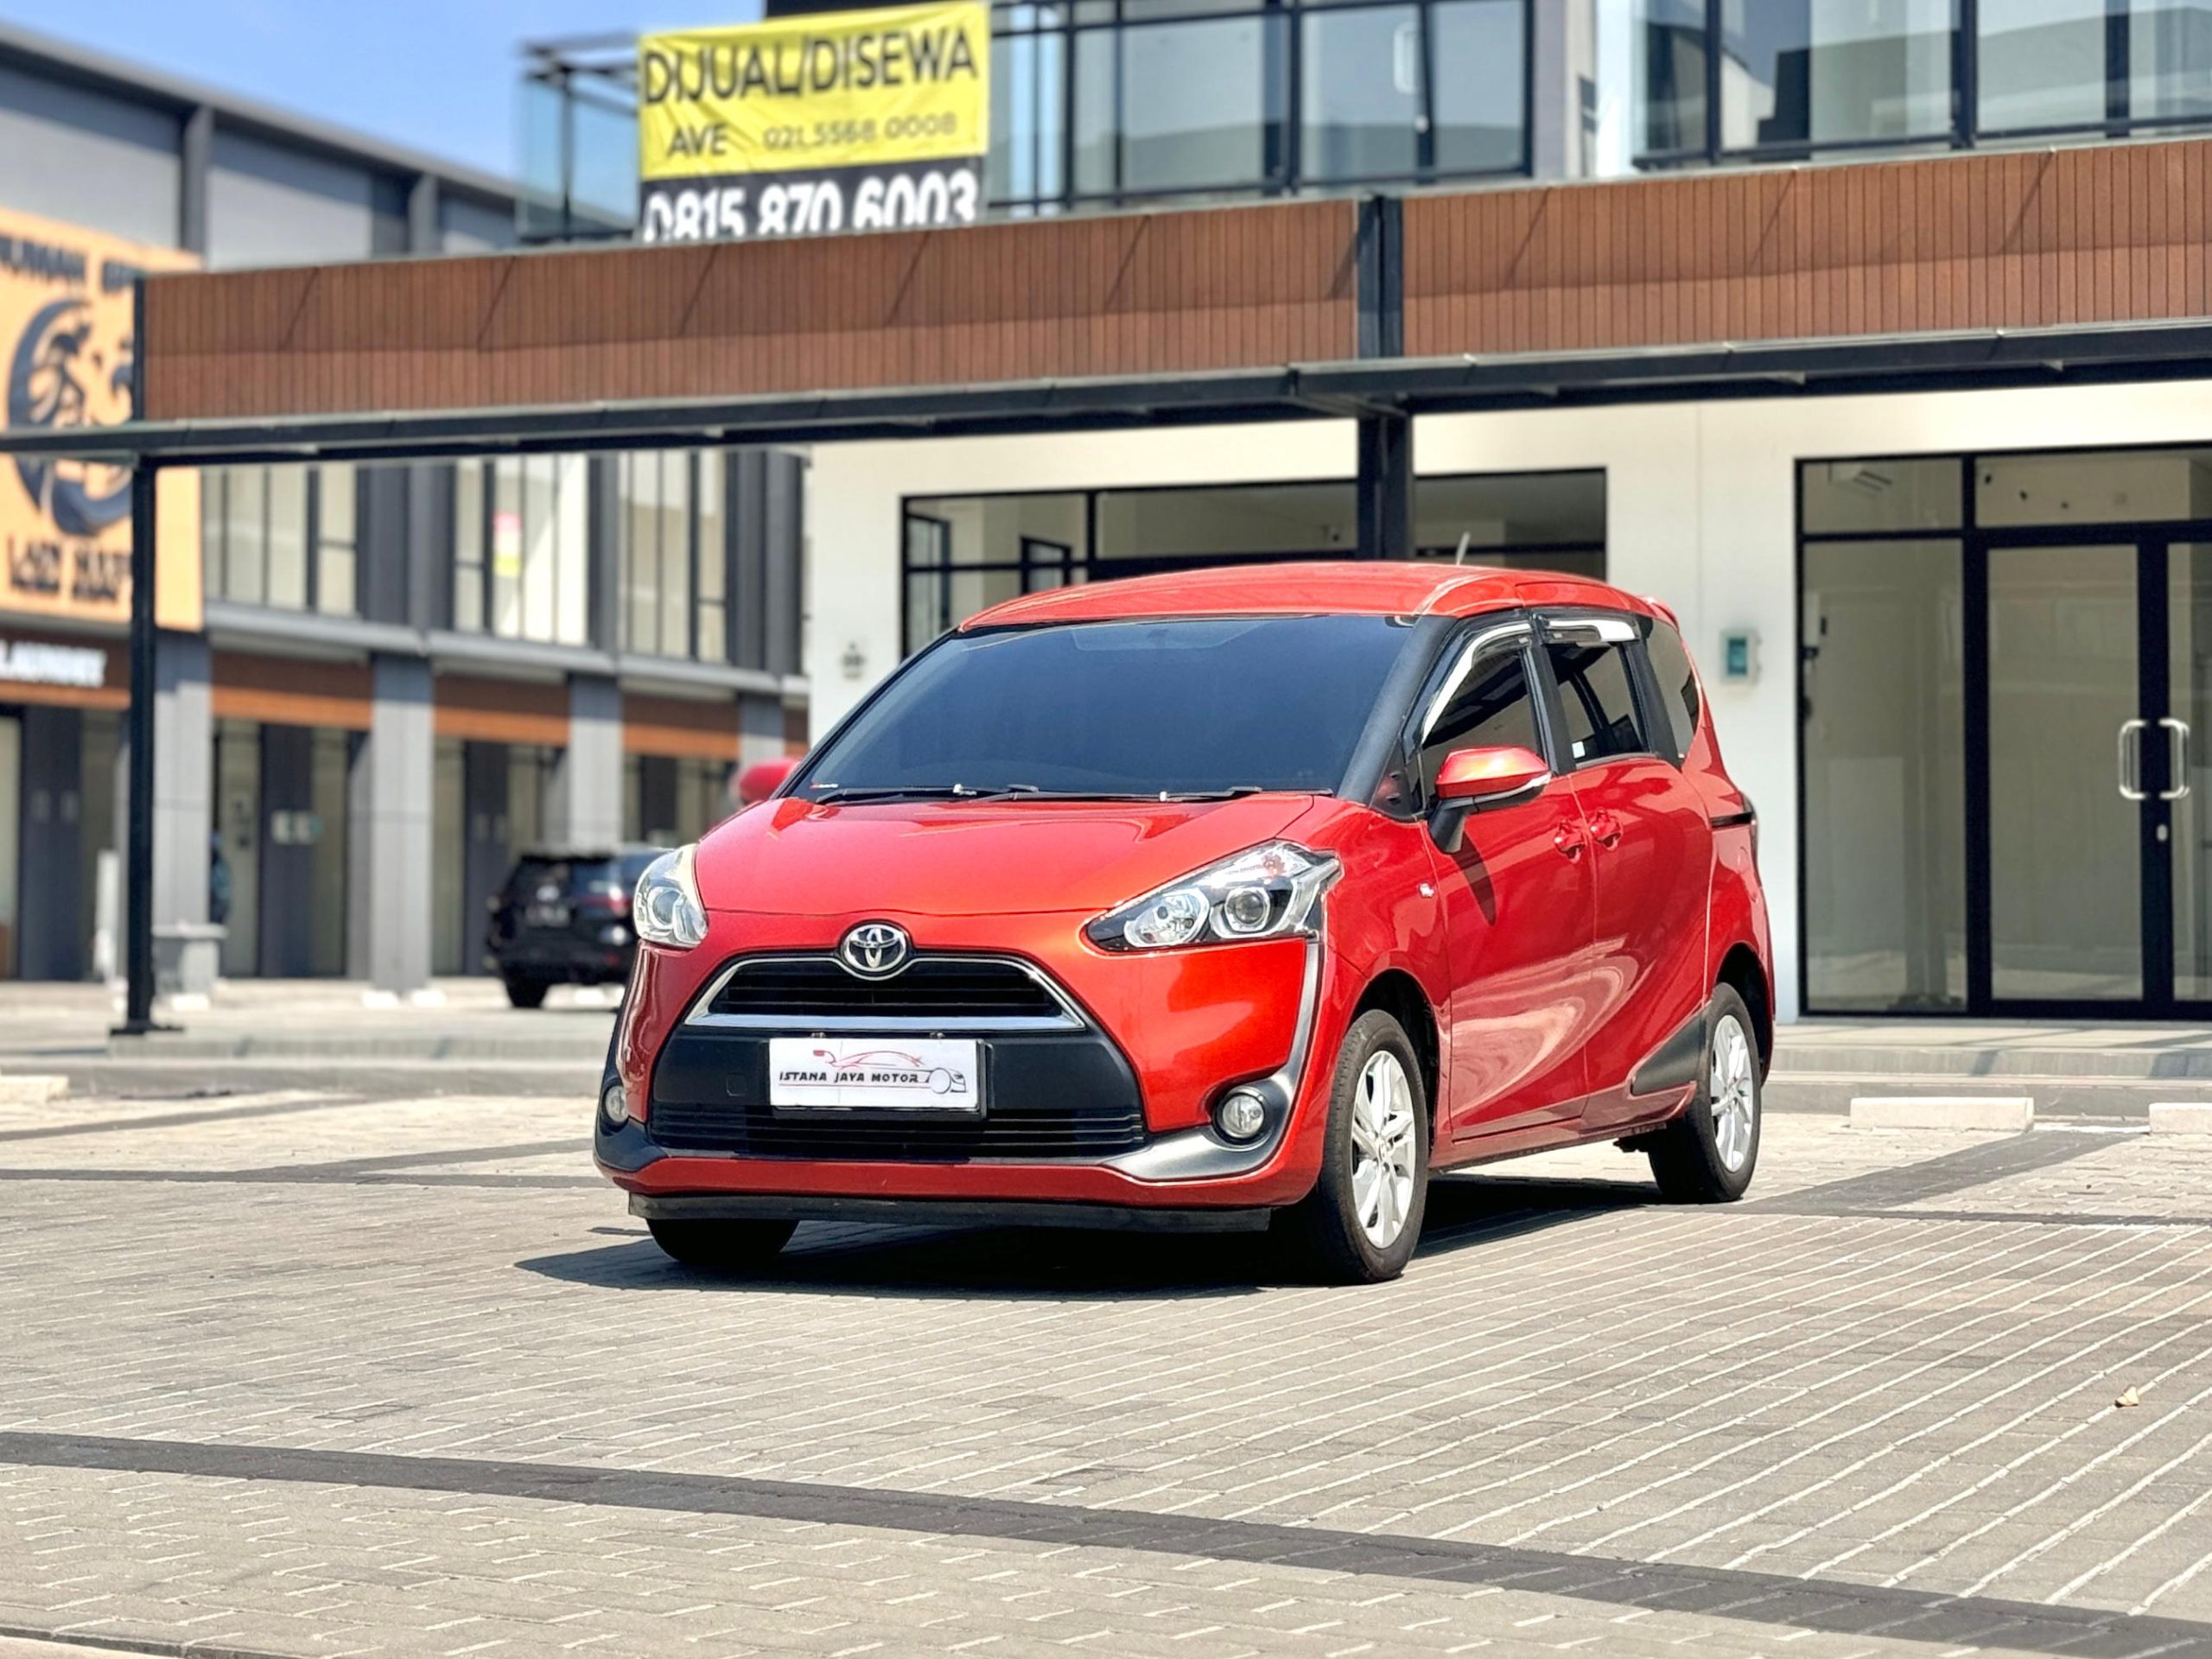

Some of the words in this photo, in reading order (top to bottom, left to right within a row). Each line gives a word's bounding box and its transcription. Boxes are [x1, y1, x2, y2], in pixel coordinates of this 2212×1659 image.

[645, 26, 979, 105] DIJUAL/DISEWA
[667, 123, 728, 157] AVE
[644, 188, 747, 243] 0815
[757, 180, 843, 236] 870
[853, 168, 977, 228] 6003
[779, 1071, 827, 1081] ISTANA
[834, 1072, 865, 1083] JAYA
[871, 1073, 918, 1083] MOTOR
